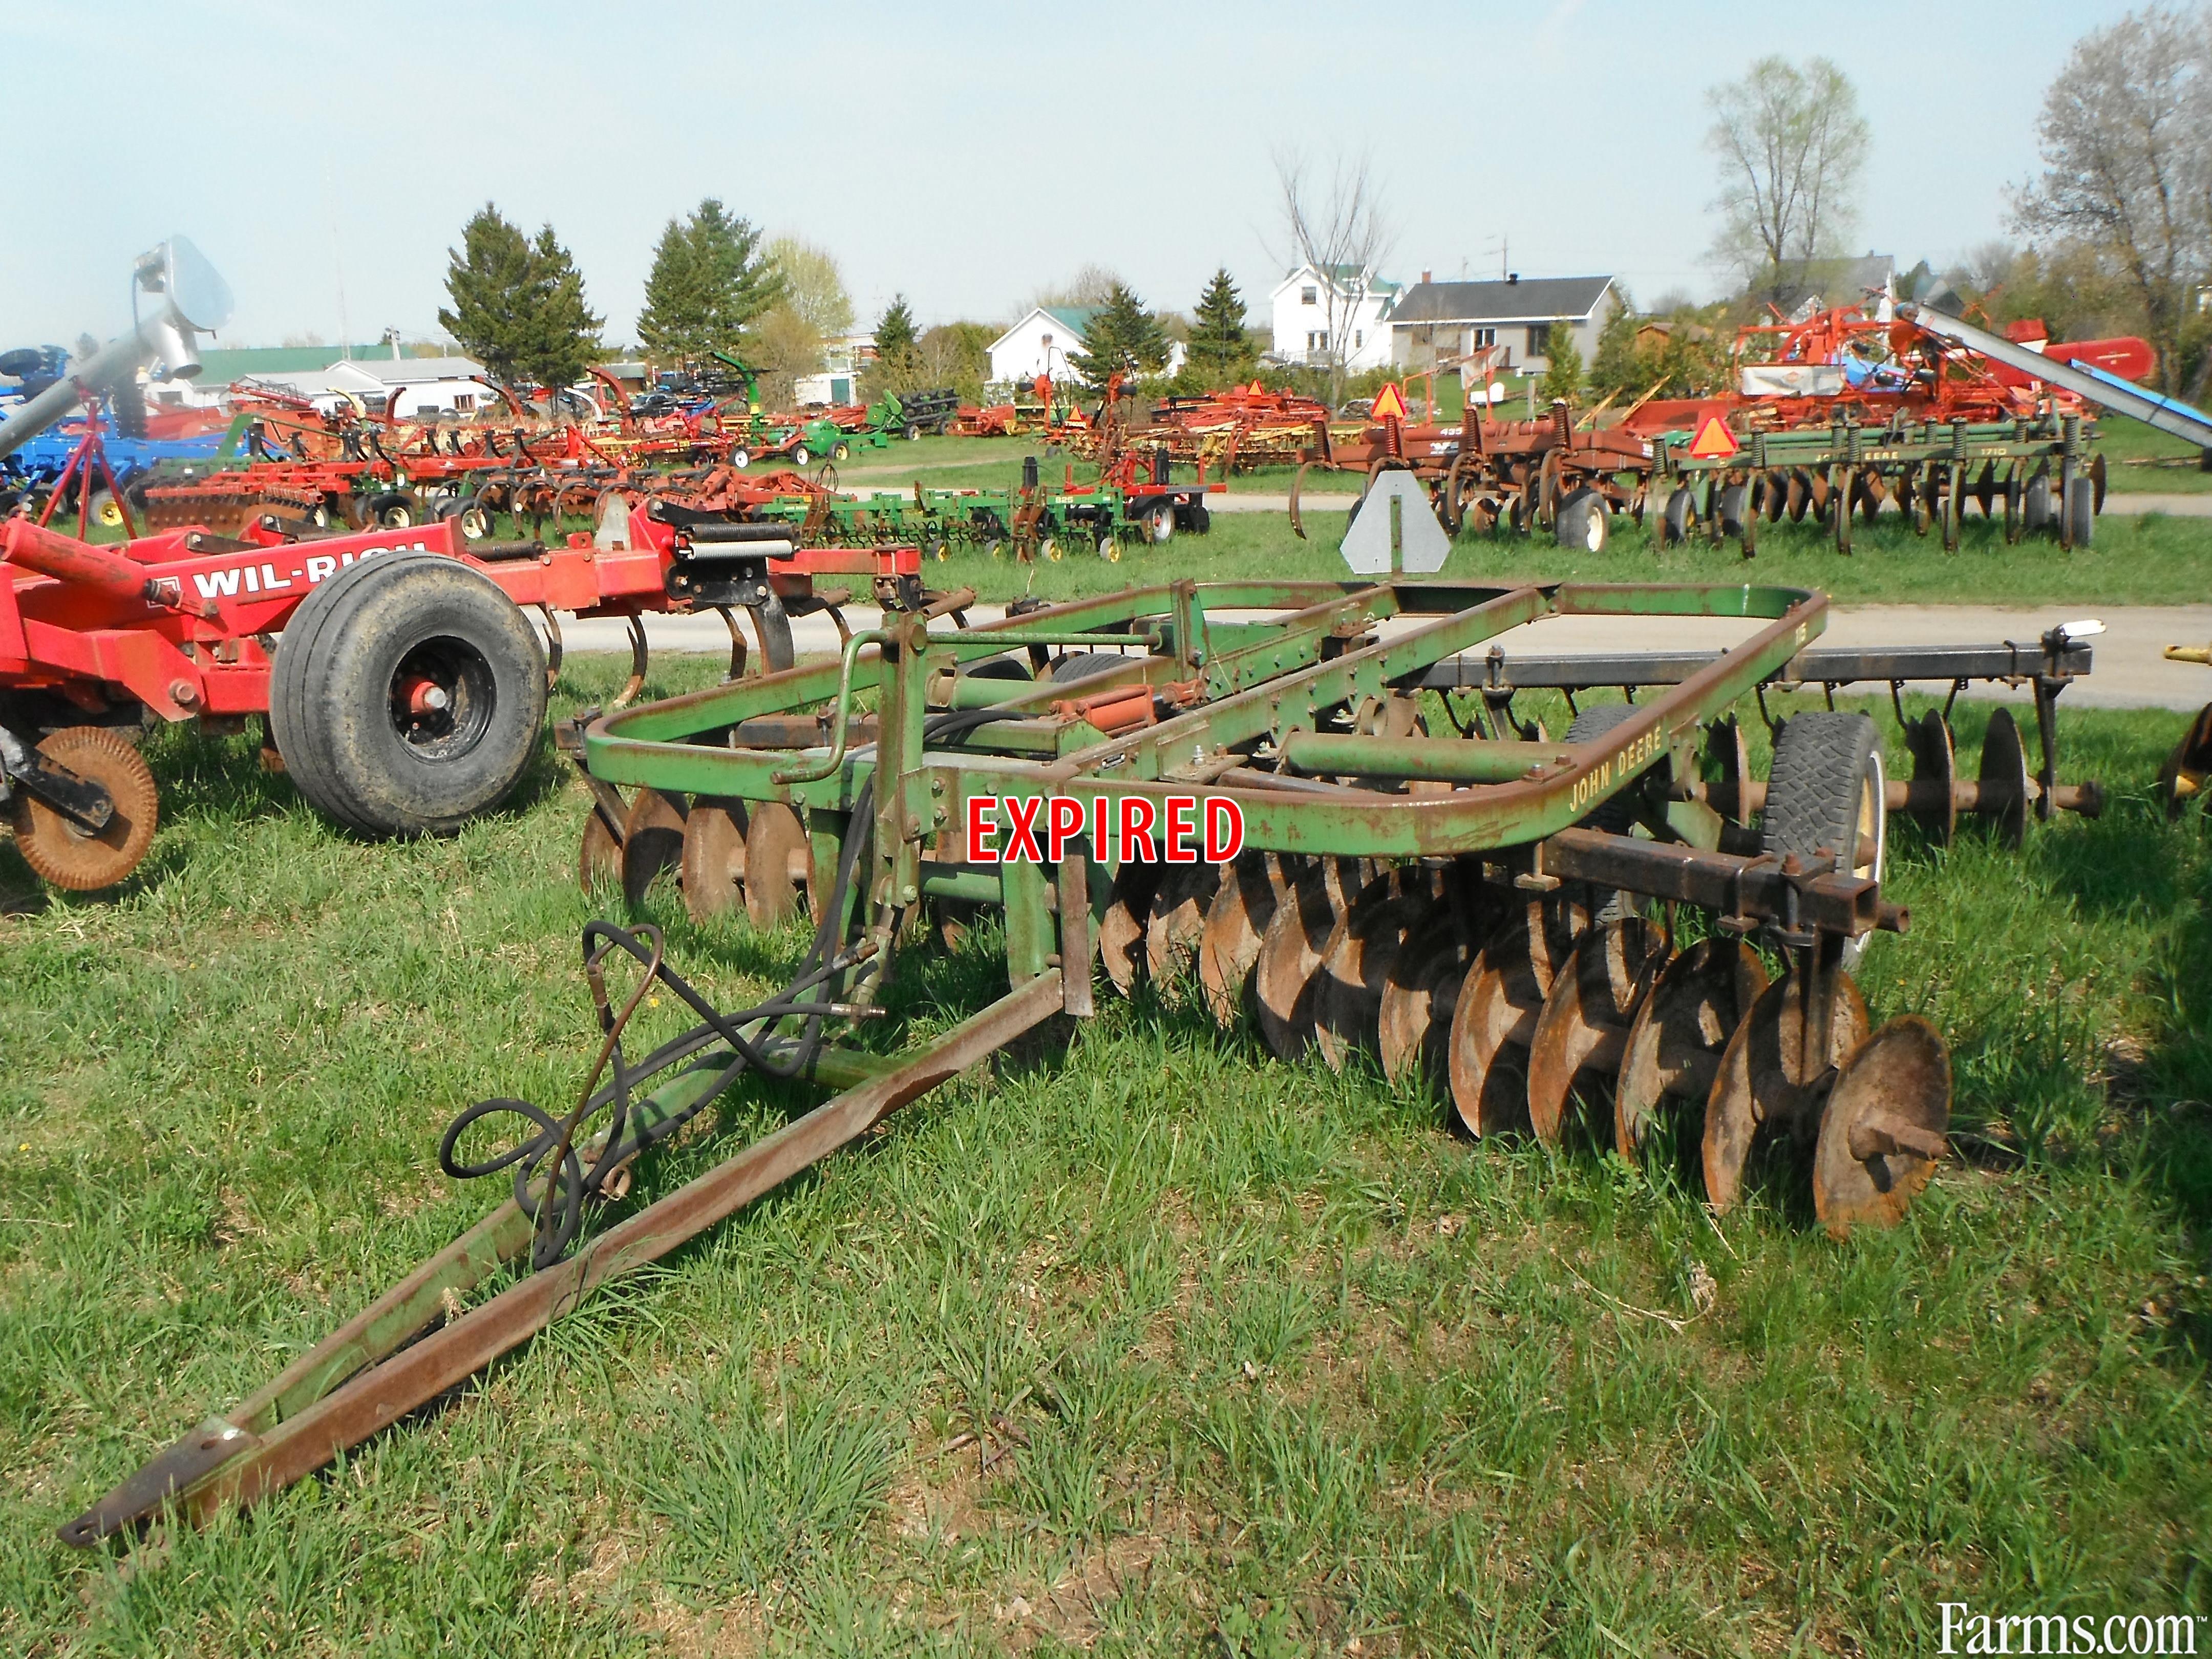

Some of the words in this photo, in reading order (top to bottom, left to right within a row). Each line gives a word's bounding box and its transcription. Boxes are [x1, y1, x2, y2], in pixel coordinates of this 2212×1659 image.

[1865, 451, 1899, 460] EERE
[1569, 761, 1610, 812] JOHN
[1618, 726, 1661, 777] DEERE
